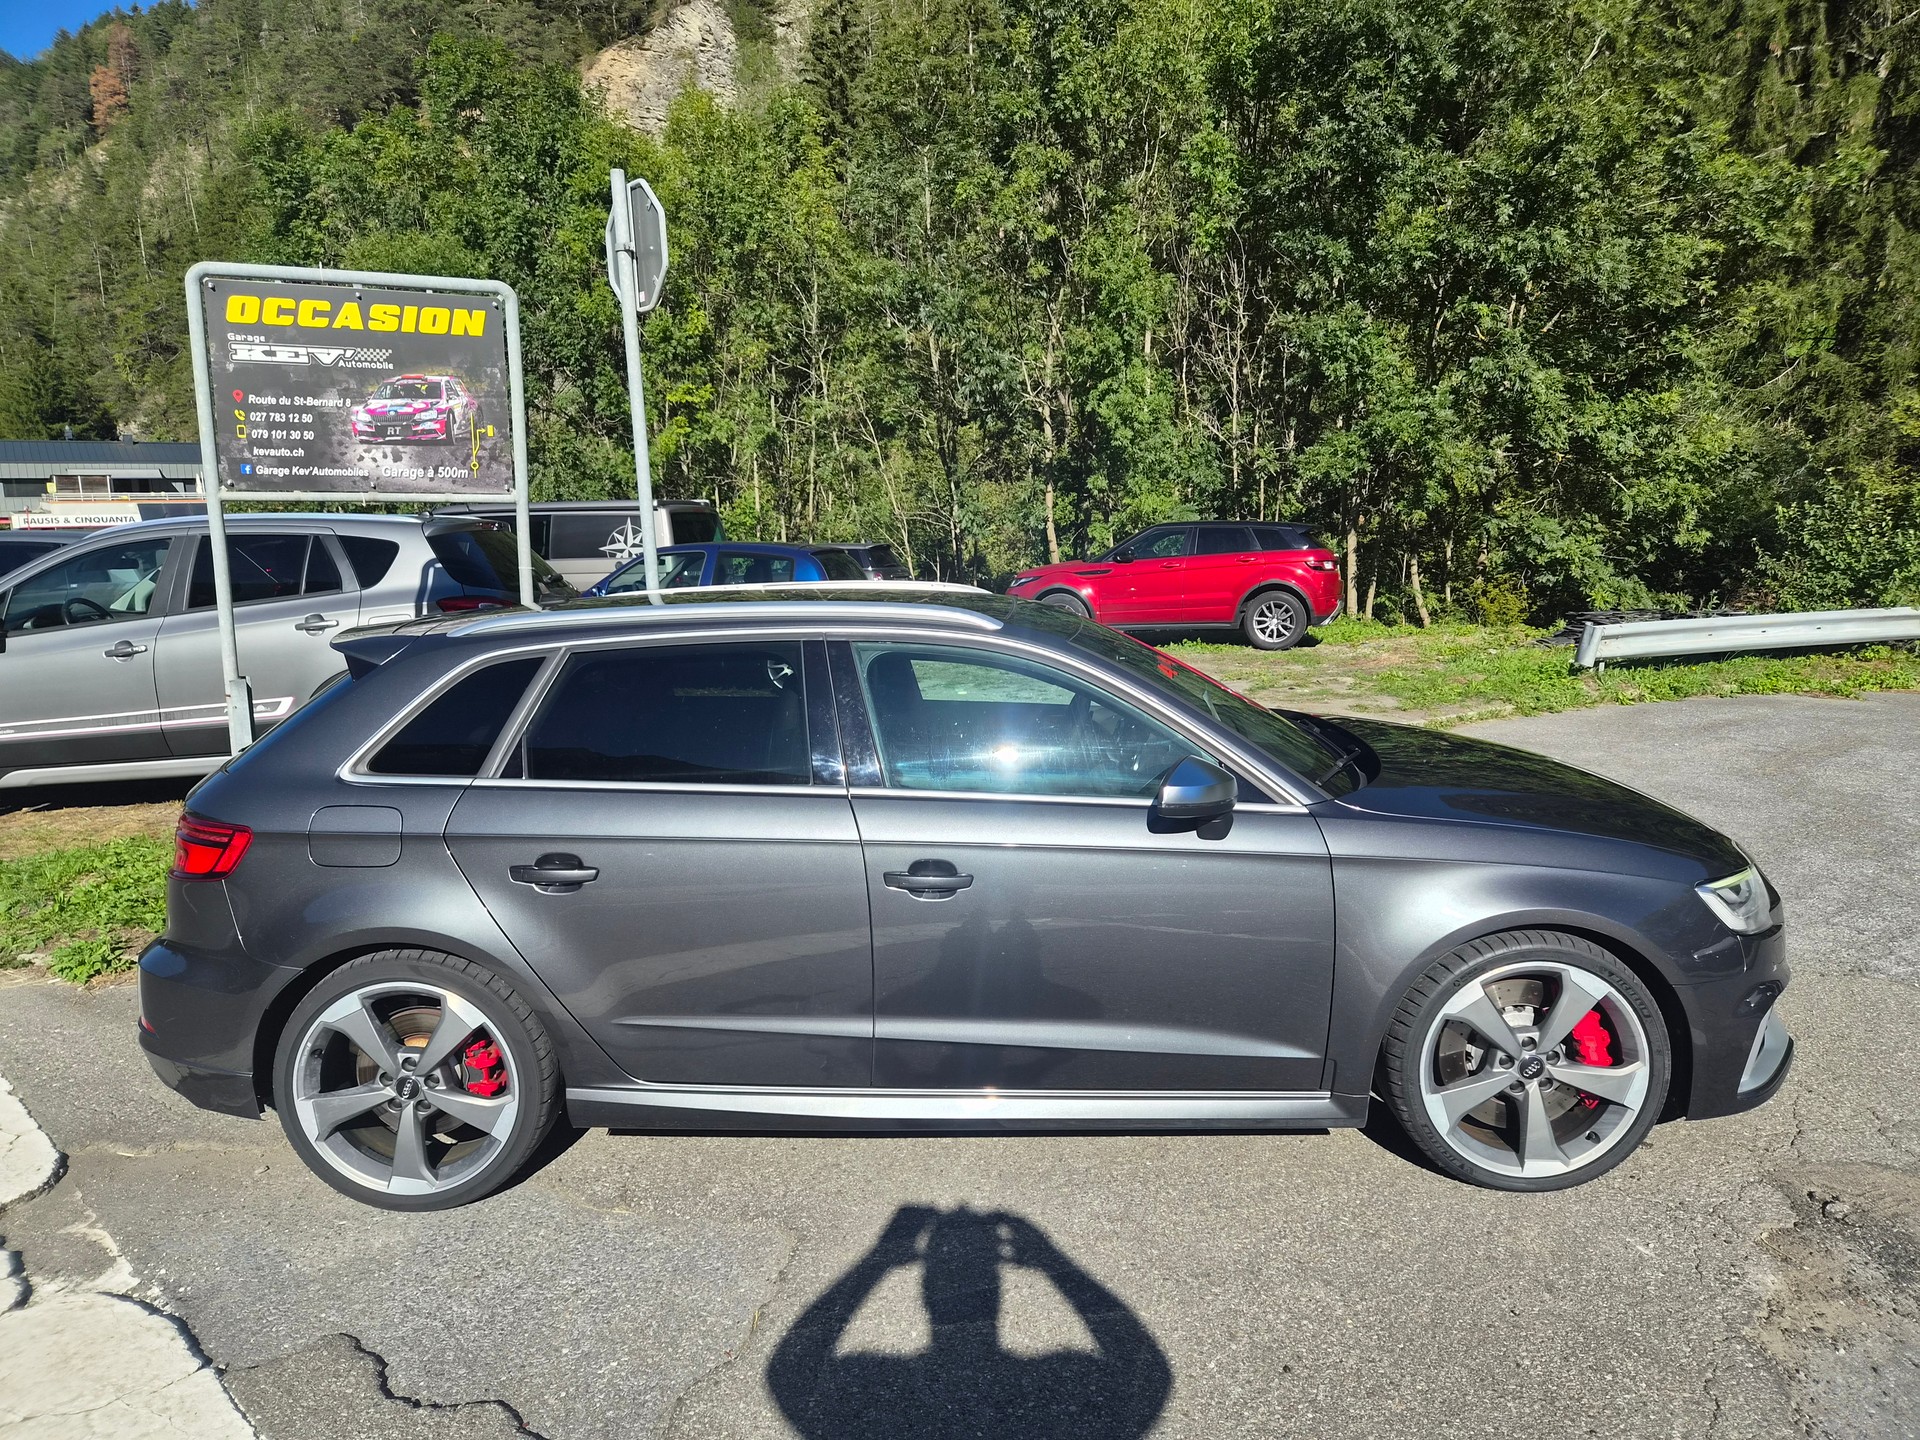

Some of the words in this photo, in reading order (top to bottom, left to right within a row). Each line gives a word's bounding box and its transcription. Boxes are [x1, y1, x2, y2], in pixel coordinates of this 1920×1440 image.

[225, 295, 486, 337] OCCASION
[227, 332, 266, 343] Garage
[338, 359, 394, 370] Automobile
[248, 395, 278, 404] Route
[279, 396, 291, 405] du
[294, 398, 343, 407] St-Bernard
[345, 398, 352, 408] 8
[250, 412, 266, 421] 027
[269, 412, 286, 422] 783
[289, 413, 300, 422] 12
[301, 414, 313, 424] 50
[251, 429, 268, 438] 079
[271, 430, 287, 439] 101
[289, 431, 301, 440] 30
[303, 431, 315, 440] 50
[253, 446, 304, 457] kevauto.ch
[256, 465, 290, 476] Garage
[382, 466, 424, 479] Garage
[427, 467, 434, 477] à
[437, 467, 469, 478] 500m
[23, 517, 59, 525] RAUSIS
[75, 516, 136, 524] CINQUANTA
